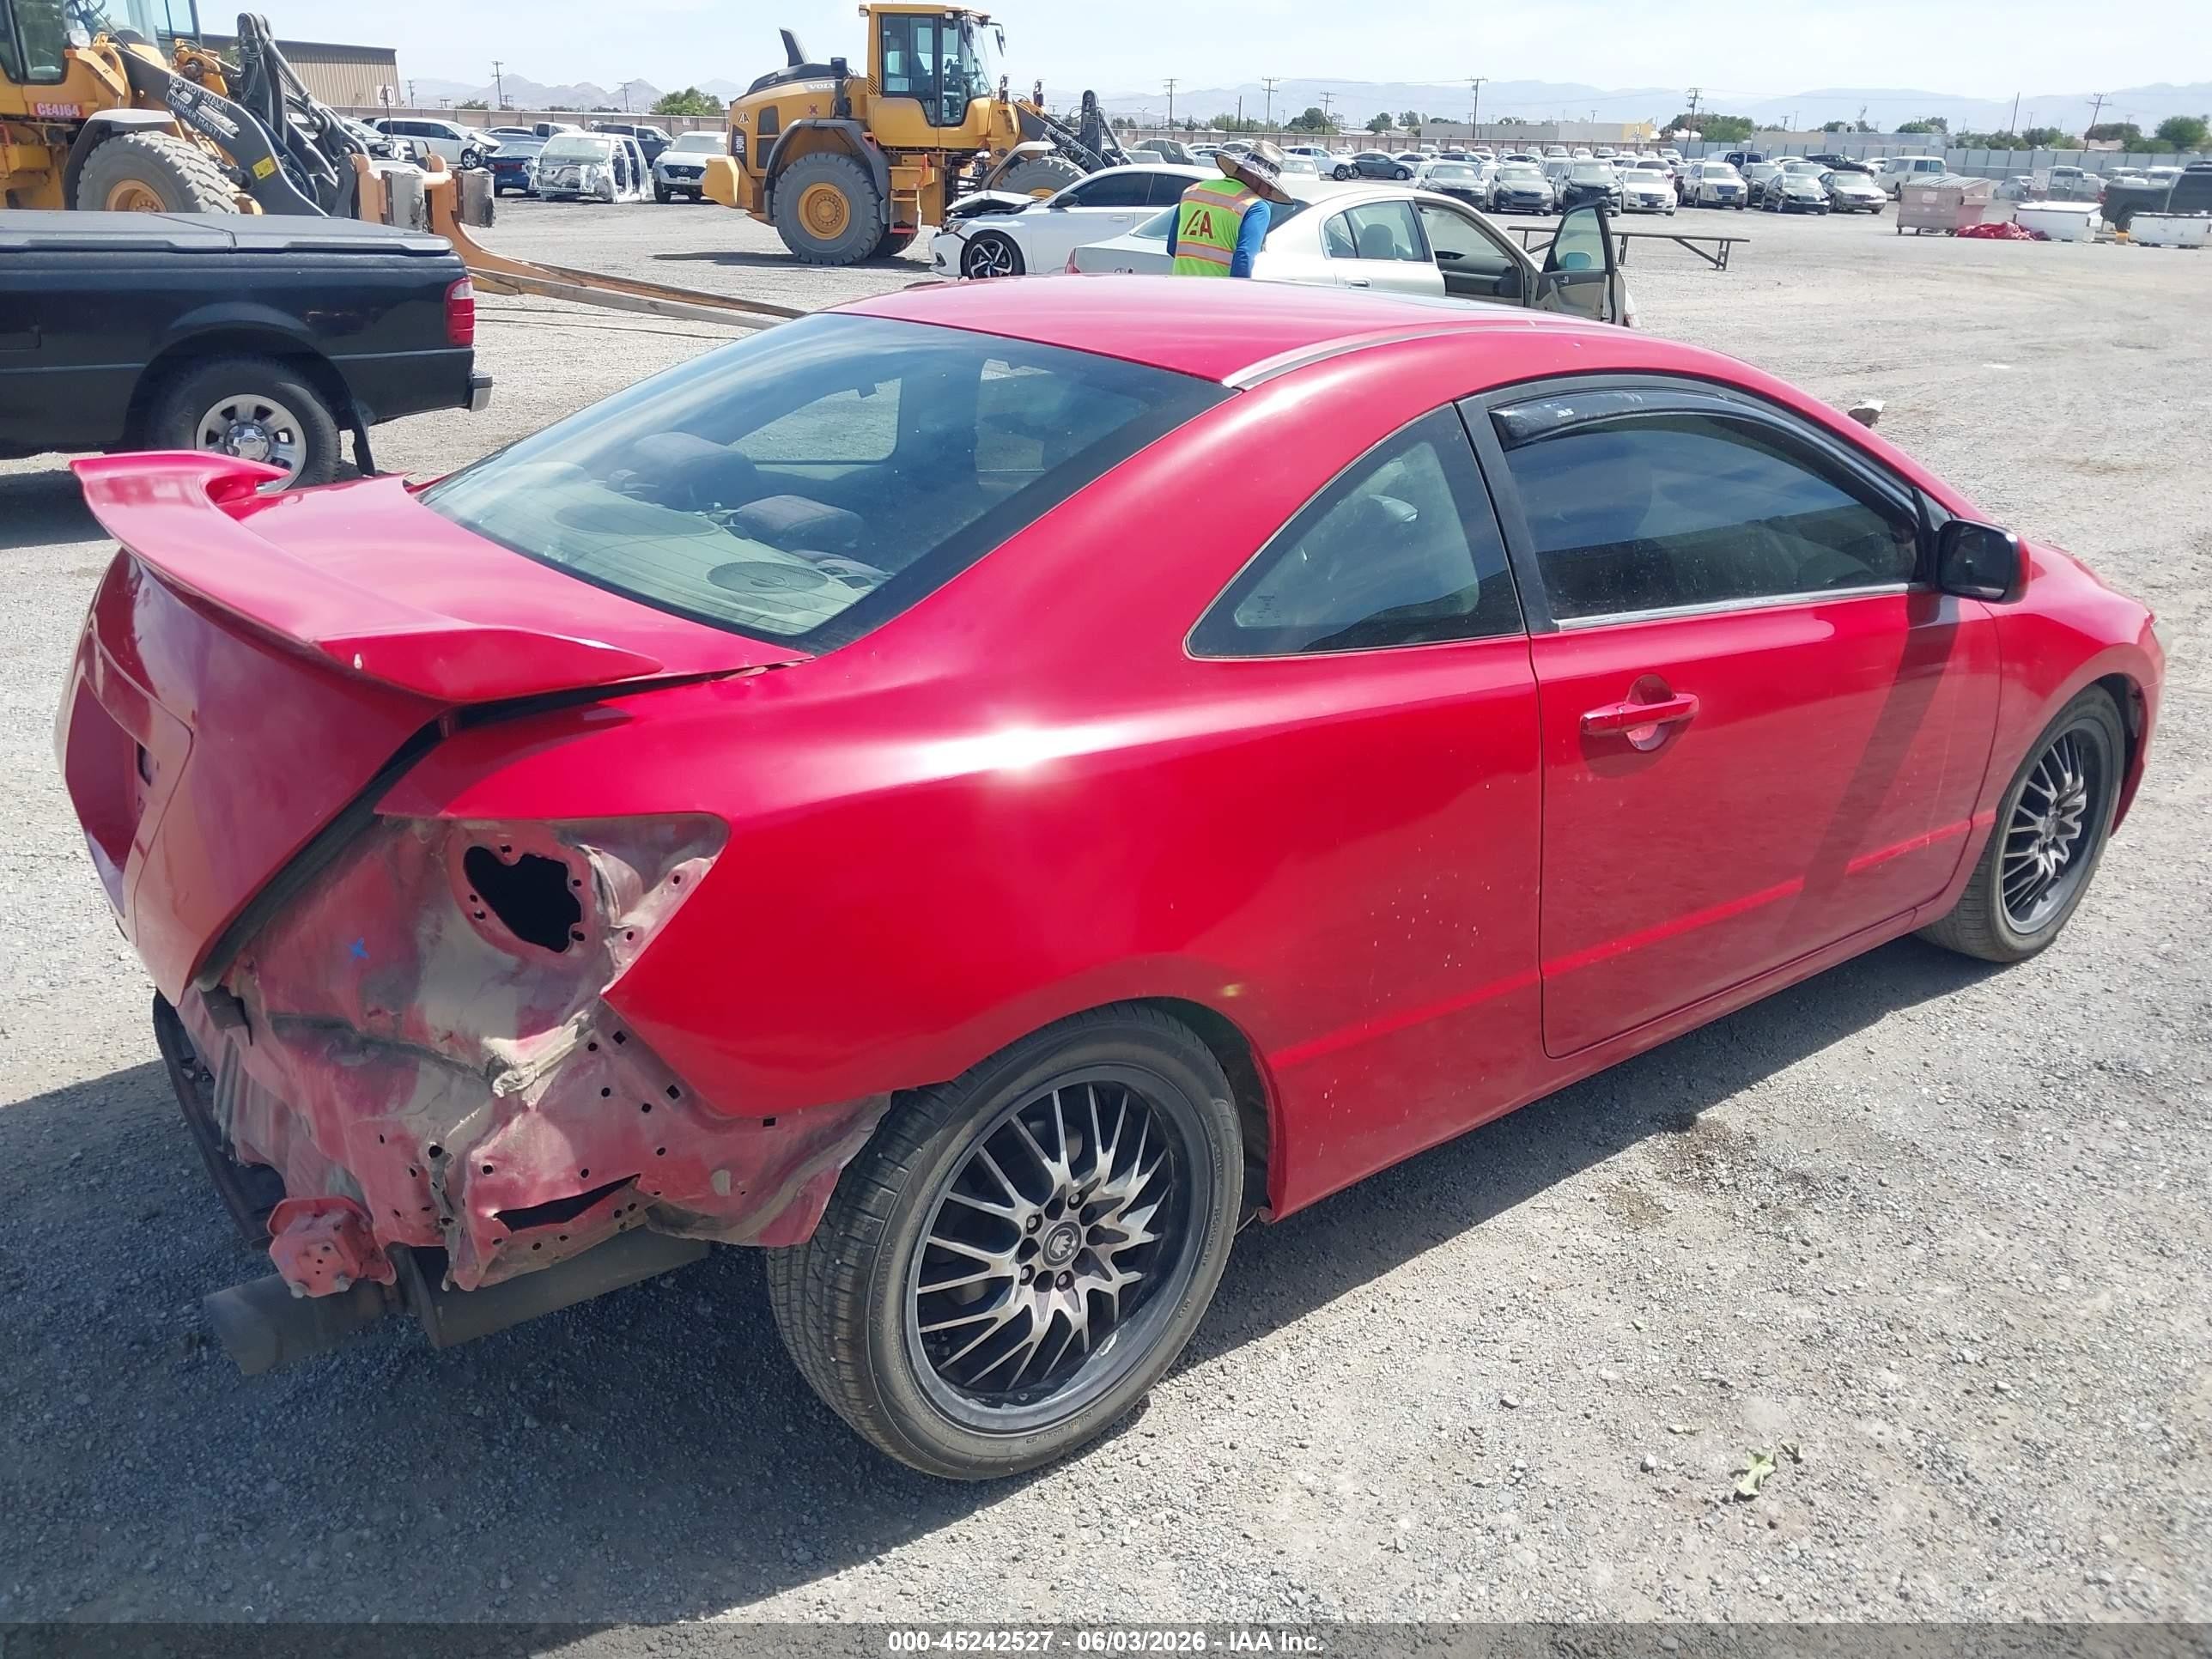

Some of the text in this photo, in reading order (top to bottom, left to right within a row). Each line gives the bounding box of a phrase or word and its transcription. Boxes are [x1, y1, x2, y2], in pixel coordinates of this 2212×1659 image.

[172, 78, 226, 107] DO NOT WALK
[172, 97, 220, 136] UNDER MAST
